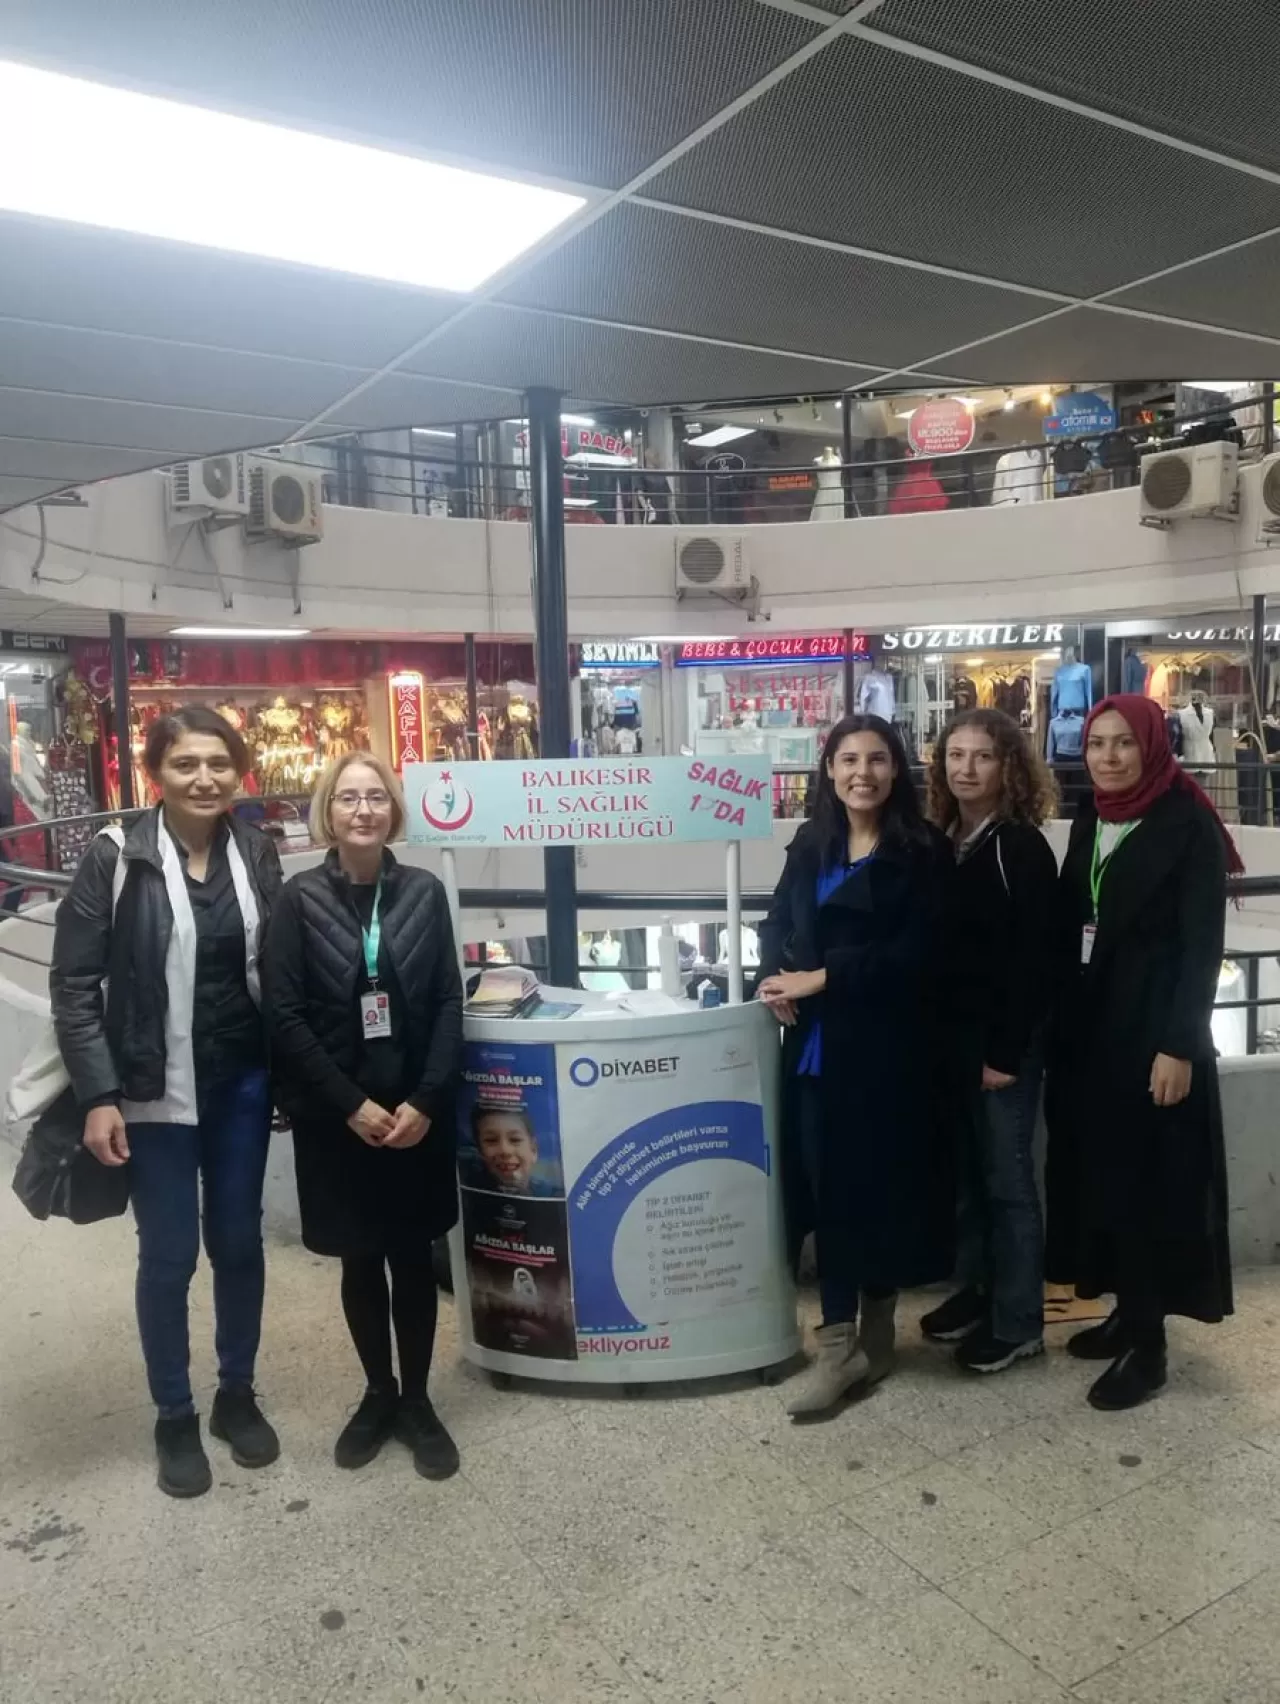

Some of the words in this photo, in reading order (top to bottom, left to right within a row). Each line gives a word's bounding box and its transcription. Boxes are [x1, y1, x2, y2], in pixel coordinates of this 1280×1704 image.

[682, 641, 726, 657] BEBE
[730, 642, 741, 656] &
[746, 637, 804, 659] ÇOCUK
[398, 686, 419, 762] KAFTA
[522, 763, 652, 788] BALIKESİR
[688, 761, 768, 801] SAĞLIK
[528, 792, 549, 815] İL
[557, 791, 649, 813] SAĞLIK
[503, 815, 675, 842] MÜDÜRLÜĞÜ
[600, 1056, 680, 1078] DİYABET
[498, 1073, 543, 1087] BAŞLAR
[597, 1182, 612, 1196] tip
[615, 1145, 651, 1176] diyabet
[700, 1125, 728, 1134] varsa
[576, 1189, 592, 1210] Aile
[576, 1335, 670, 1356] ekliyoruz
